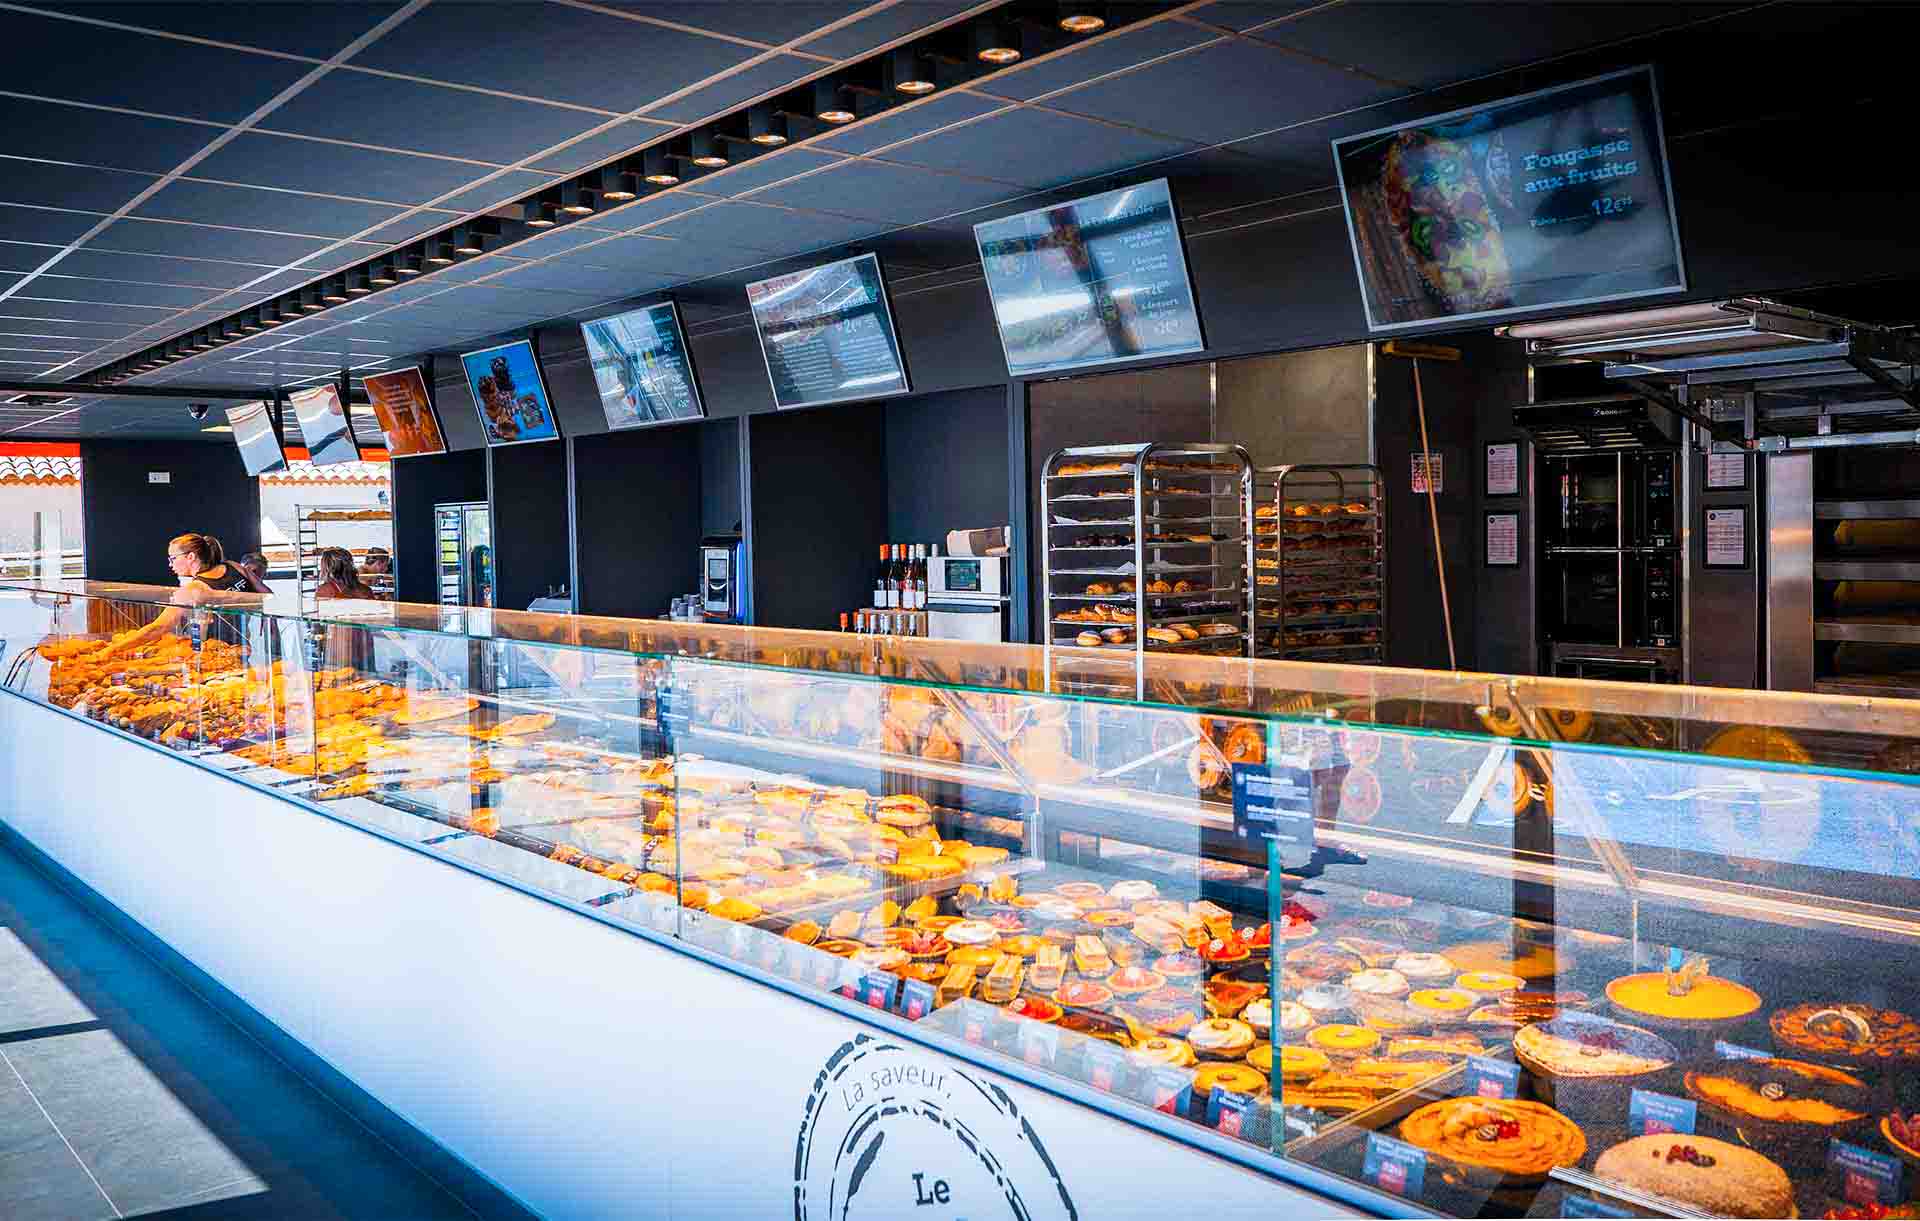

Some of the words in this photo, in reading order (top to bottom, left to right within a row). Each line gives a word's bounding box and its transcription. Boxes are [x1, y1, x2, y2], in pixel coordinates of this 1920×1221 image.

[1523, 140, 1632, 172] Fougasse
[1524, 176, 1564, 193] aux
[1567, 161, 1638, 185] fruits
[842, 1081, 864, 1111] La
[911, 1172, 951, 1206] Le
